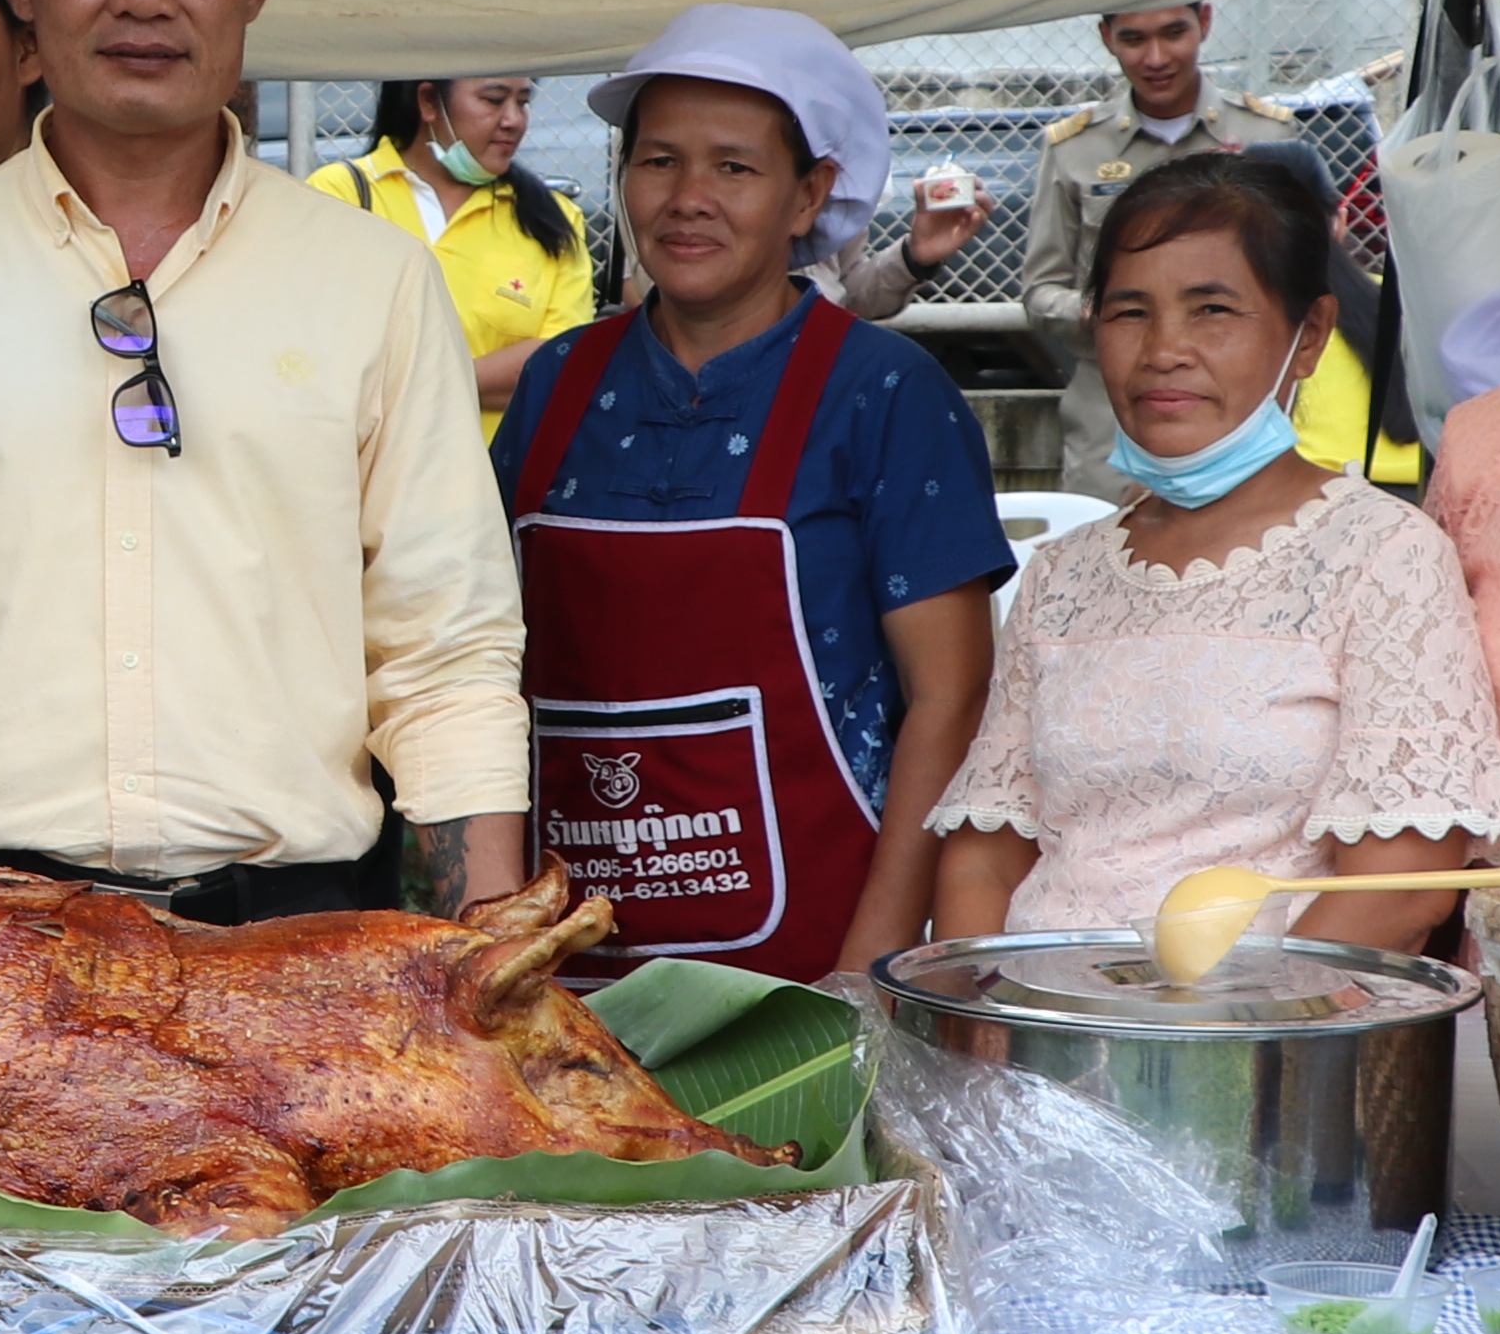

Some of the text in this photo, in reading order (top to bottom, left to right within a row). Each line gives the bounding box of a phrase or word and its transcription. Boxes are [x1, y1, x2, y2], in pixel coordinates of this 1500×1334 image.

[546, 804, 742, 854] ร้านหมูตุ๊กตา
[567, 847, 742, 879] ร.095-1266501
